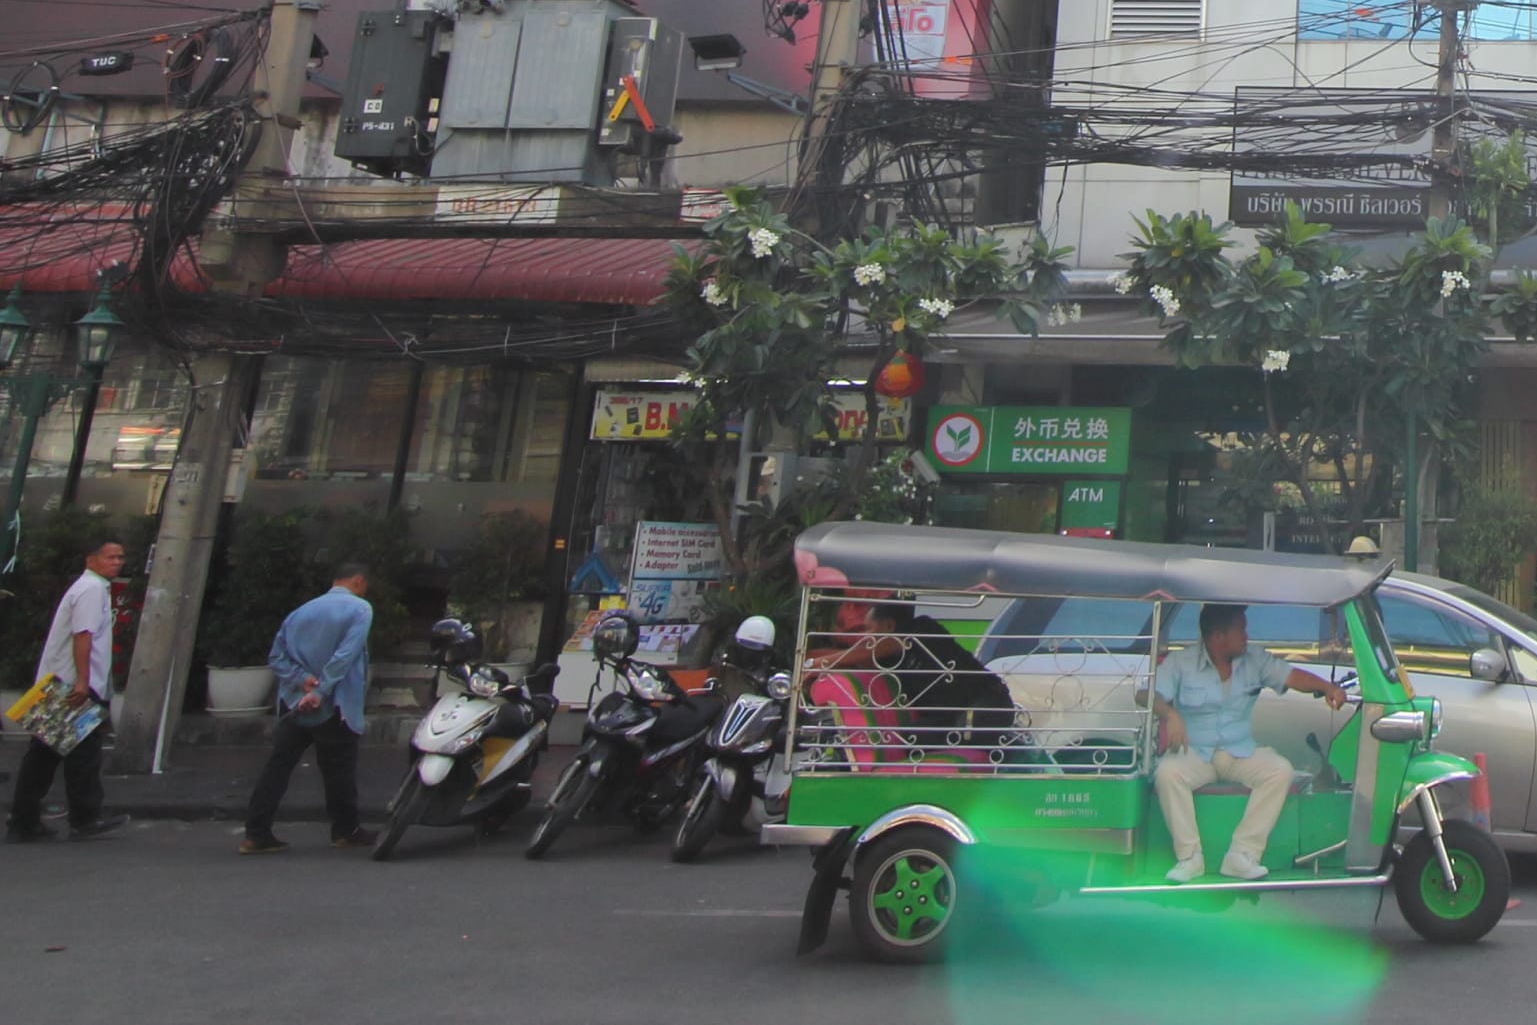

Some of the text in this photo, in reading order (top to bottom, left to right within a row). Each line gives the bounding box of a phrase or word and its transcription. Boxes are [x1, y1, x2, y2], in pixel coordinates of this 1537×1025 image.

[1013, 416, 1110, 440] 外币兑换
[1011, 447, 1108, 464] EXCHANGE
[1068, 487, 1104, 503] ATM
[639, 590, 666, 617] 4G
